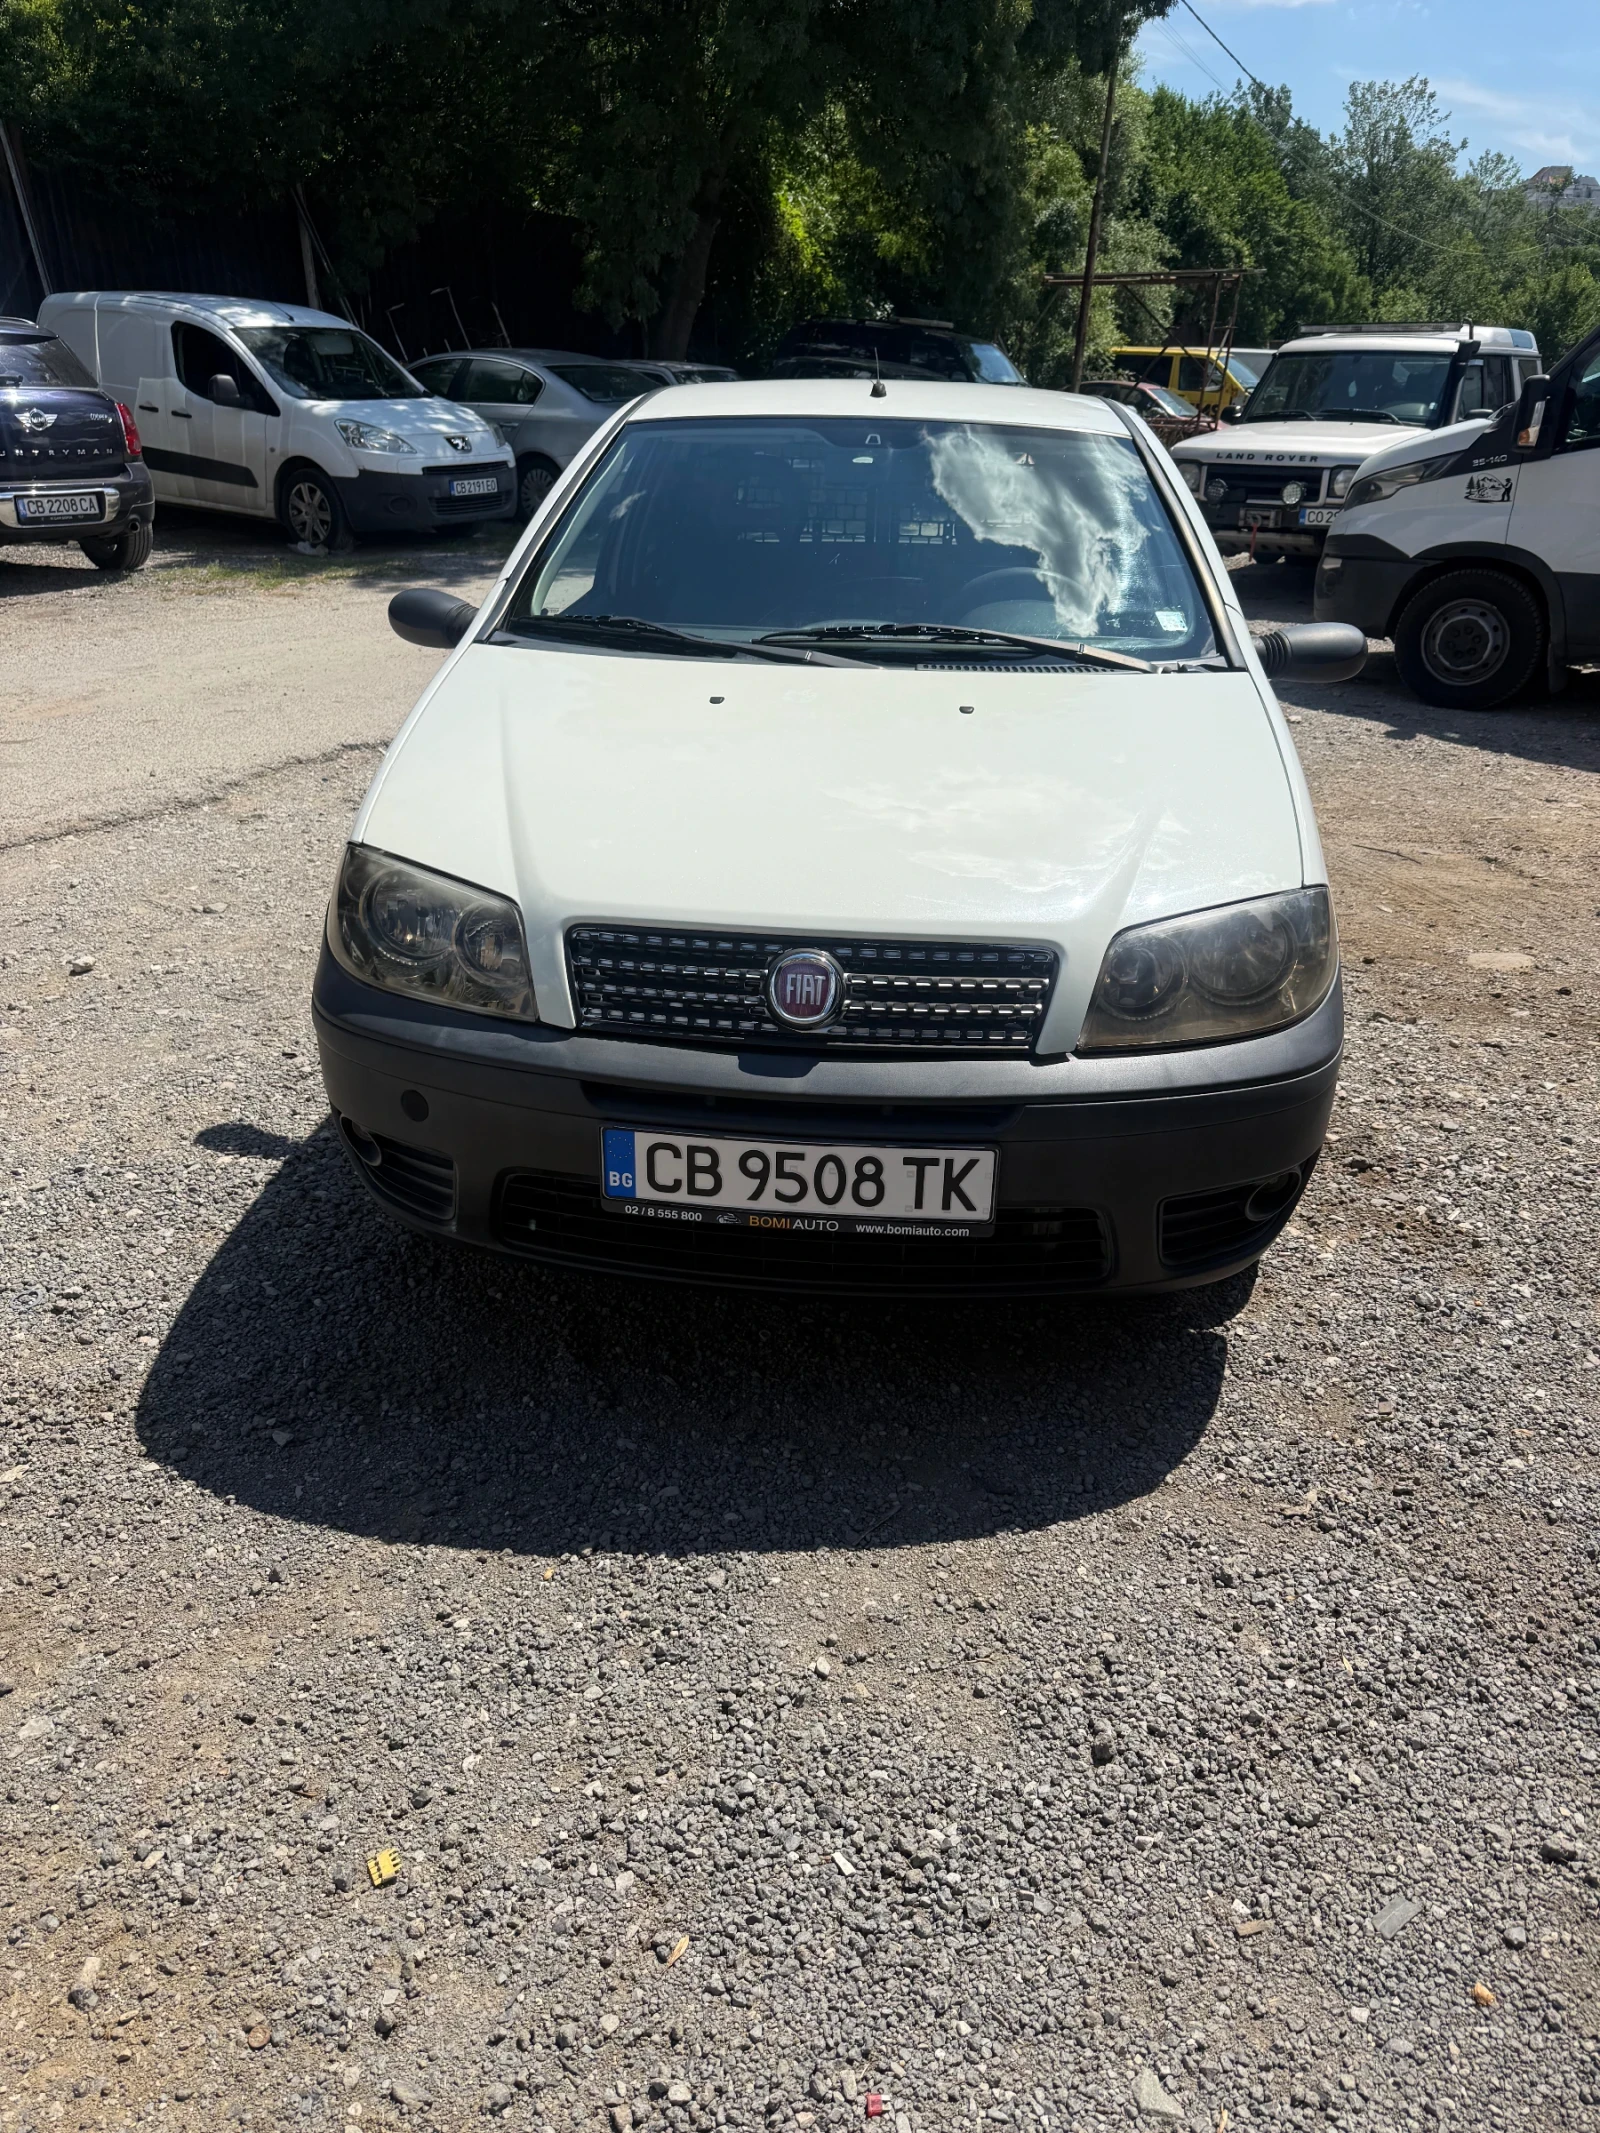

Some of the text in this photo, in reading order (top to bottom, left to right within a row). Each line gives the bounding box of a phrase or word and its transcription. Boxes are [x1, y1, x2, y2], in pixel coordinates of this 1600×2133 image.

[1216, 452, 1319, 462] LAND ROVER
[455, 482, 467, 495] CB
[467, 480, 485, 493] 2191
[26, 500, 46, 514] CB
[47, 498, 79, 514] 2208
[79, 498, 97, 512] CA
[1307, 511, 1324, 523] CO
[786, 974, 826, 1006] FIAT
[609, 1171, 633, 1188] BG
[646, 1142, 981, 1212] CB 9508 TK
[624, 1205, 639, 1215] 02
[647, 1207, 655, 1217] 8
[657, 1209, 679, 1219] 555
[681, 1211, 702, 1221] 800
[855, 1223, 970, 1237] www.bomiauto.com
